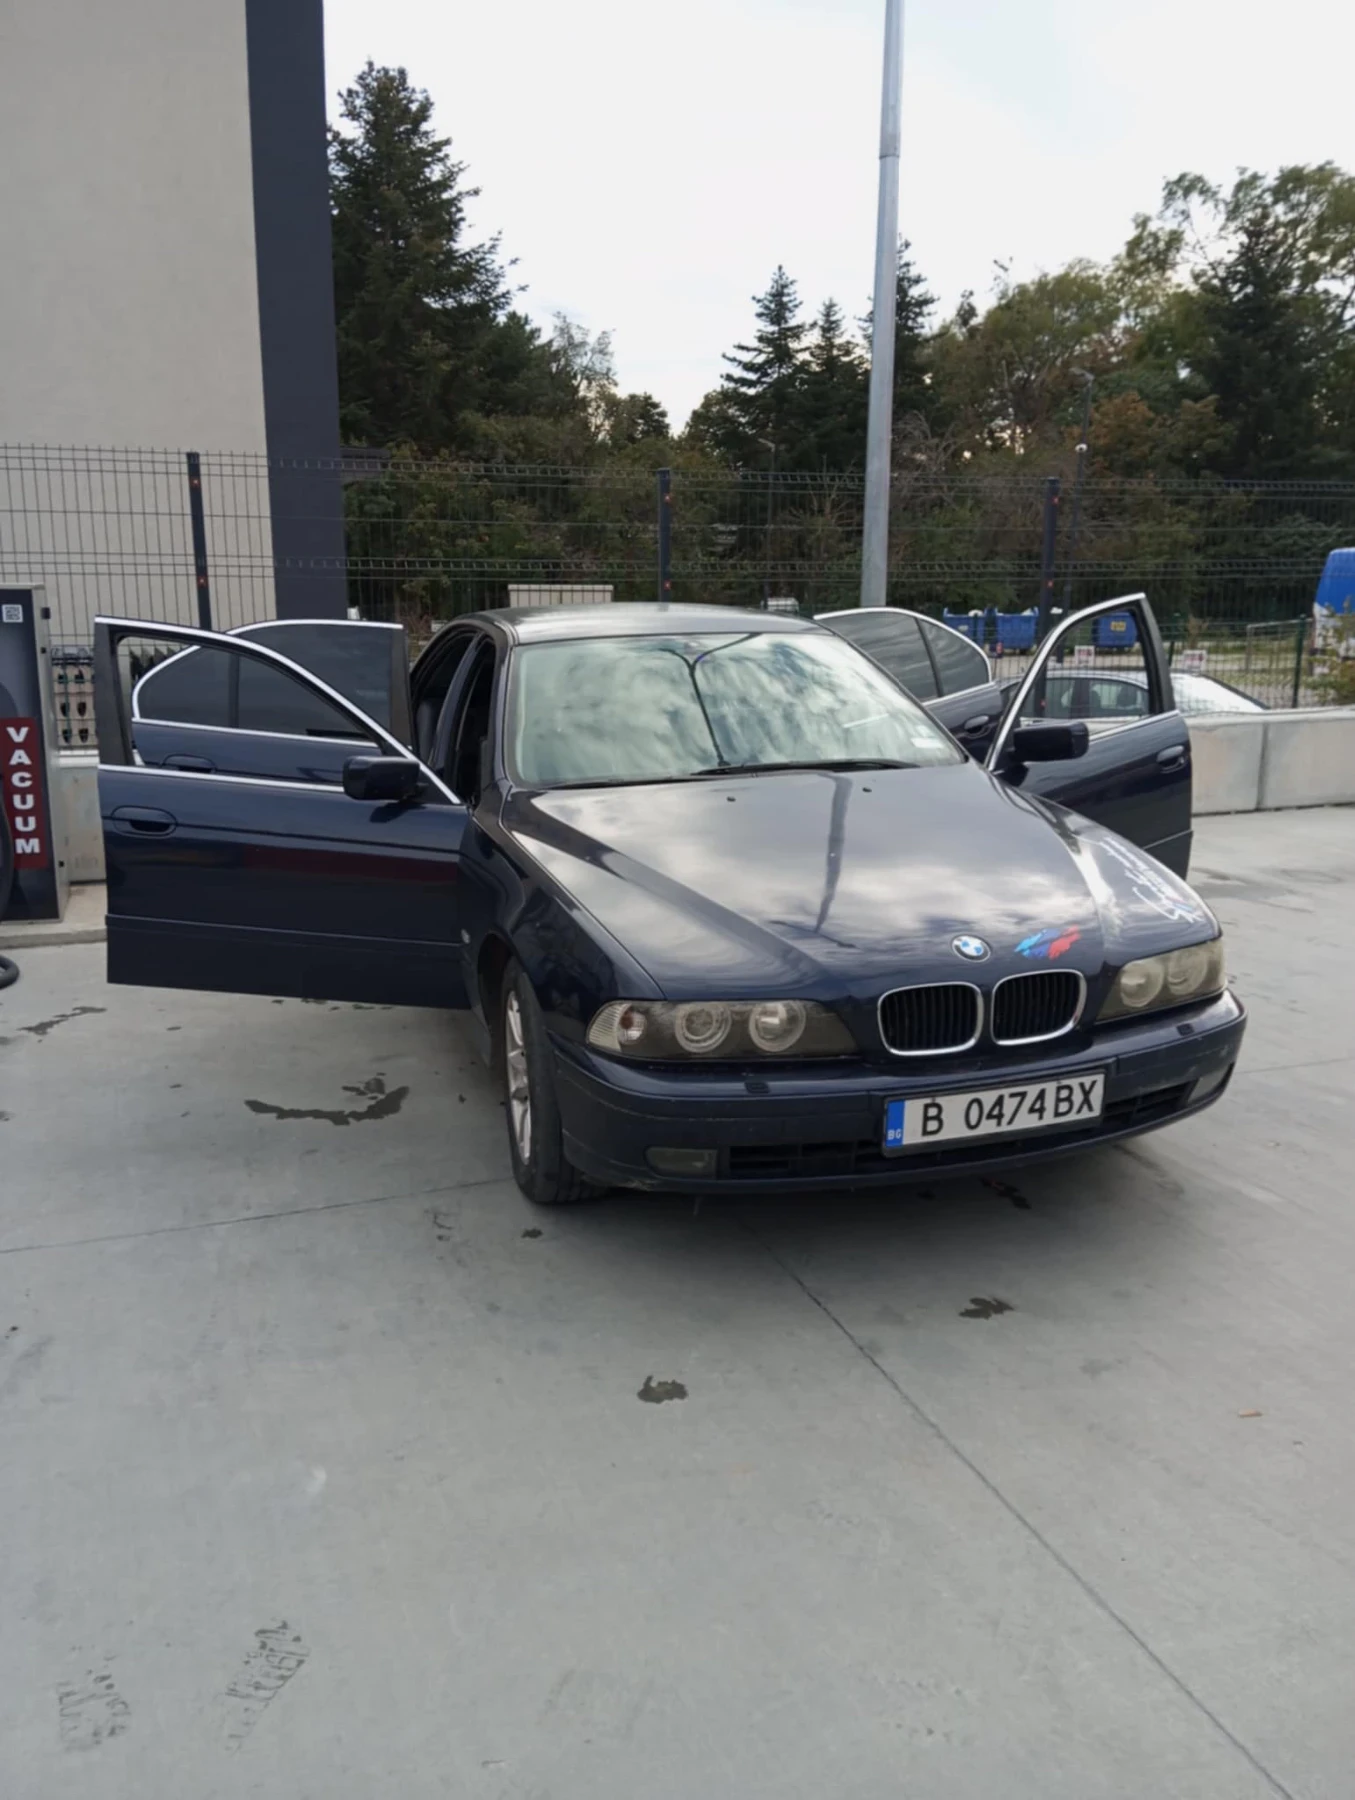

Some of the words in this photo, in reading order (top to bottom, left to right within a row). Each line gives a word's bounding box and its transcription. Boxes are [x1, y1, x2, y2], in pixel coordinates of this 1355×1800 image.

[6, 726, 41, 854] VACUUM
[887, 1128, 902, 1141] BG
[921, 1101, 944, 1137] B
